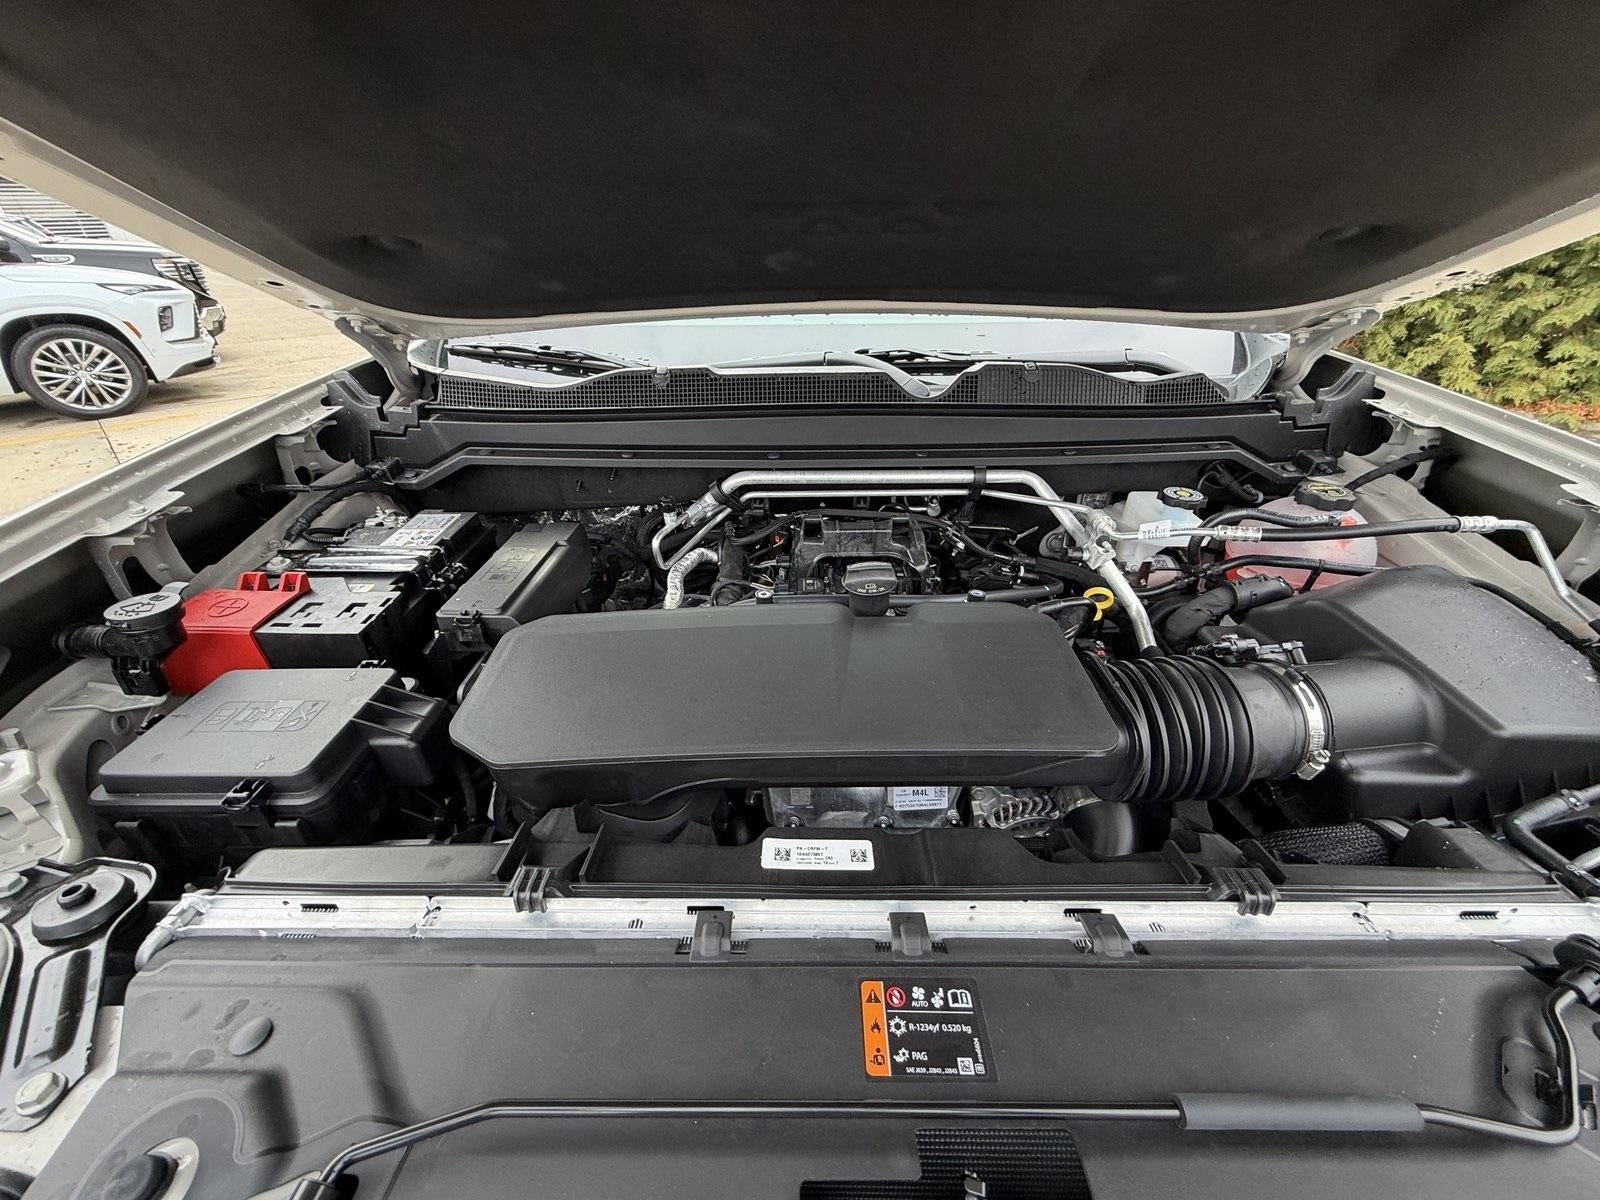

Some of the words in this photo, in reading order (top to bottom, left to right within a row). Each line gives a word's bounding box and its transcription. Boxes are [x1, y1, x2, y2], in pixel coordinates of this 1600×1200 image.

[912, 788, 929, 797] M4L
[909, 1023, 939, 1033] R-1234yf
[942, 1023, 962, 1032] 0.520
[962, 1023, 972, 1033] kg
[911, 1051, 928, 1060] PAG
